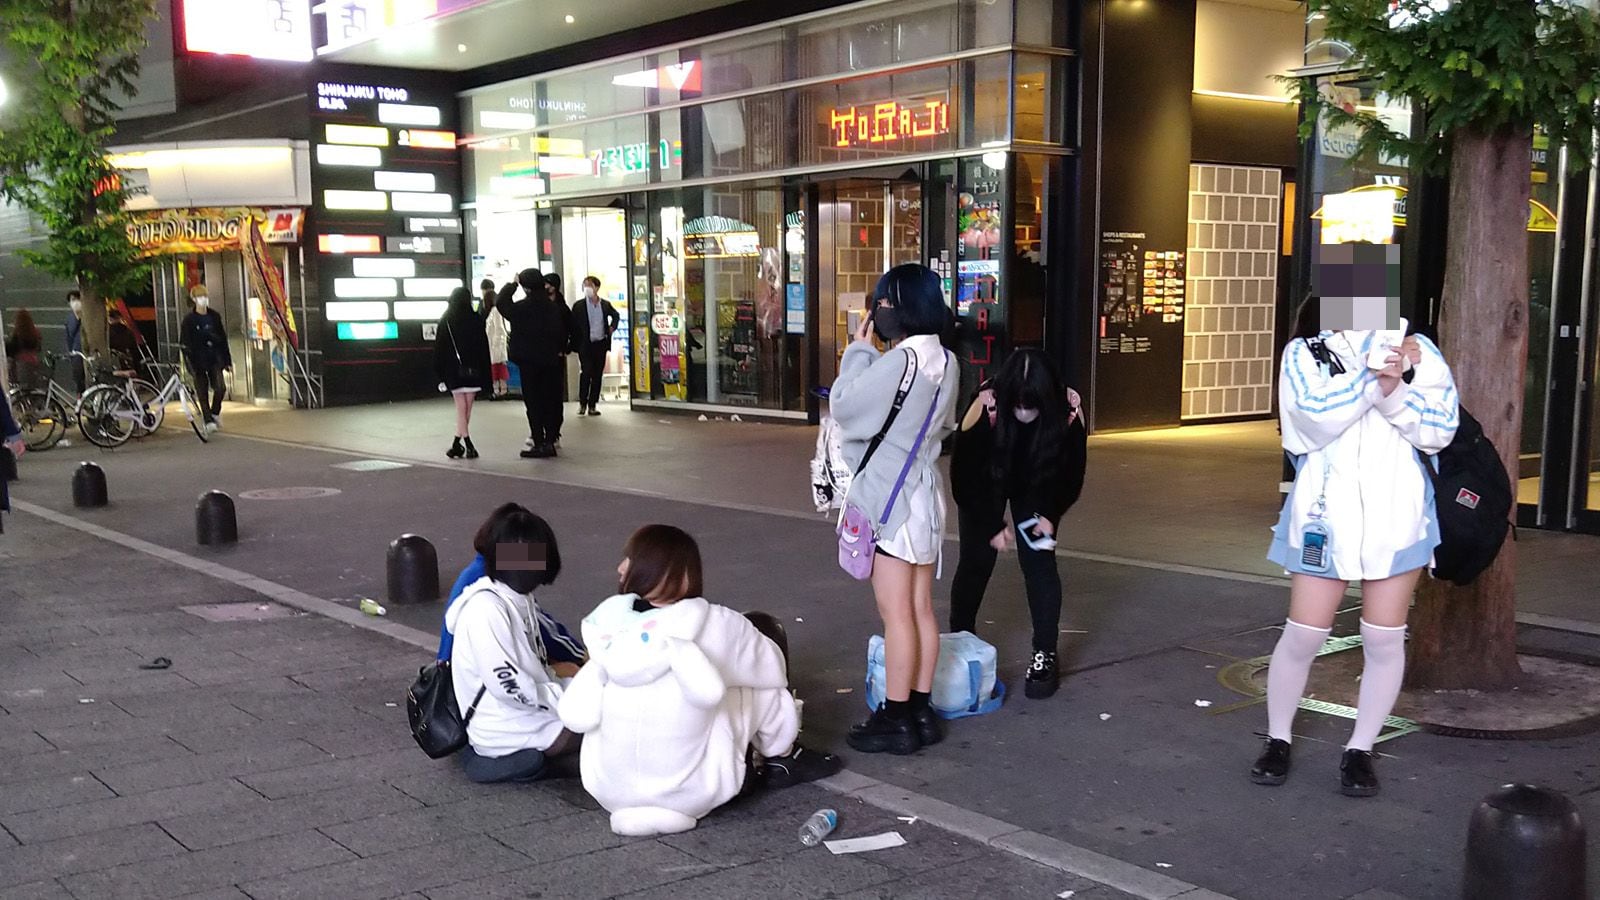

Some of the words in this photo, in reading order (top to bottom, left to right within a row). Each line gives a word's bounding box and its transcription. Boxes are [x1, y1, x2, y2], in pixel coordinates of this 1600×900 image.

[317, 82, 375, 99] SHINJUKU
[377, 86, 408, 102] TOHO
[183, 216, 240, 241] BLDG
[660, 338, 678, 356] SIM
